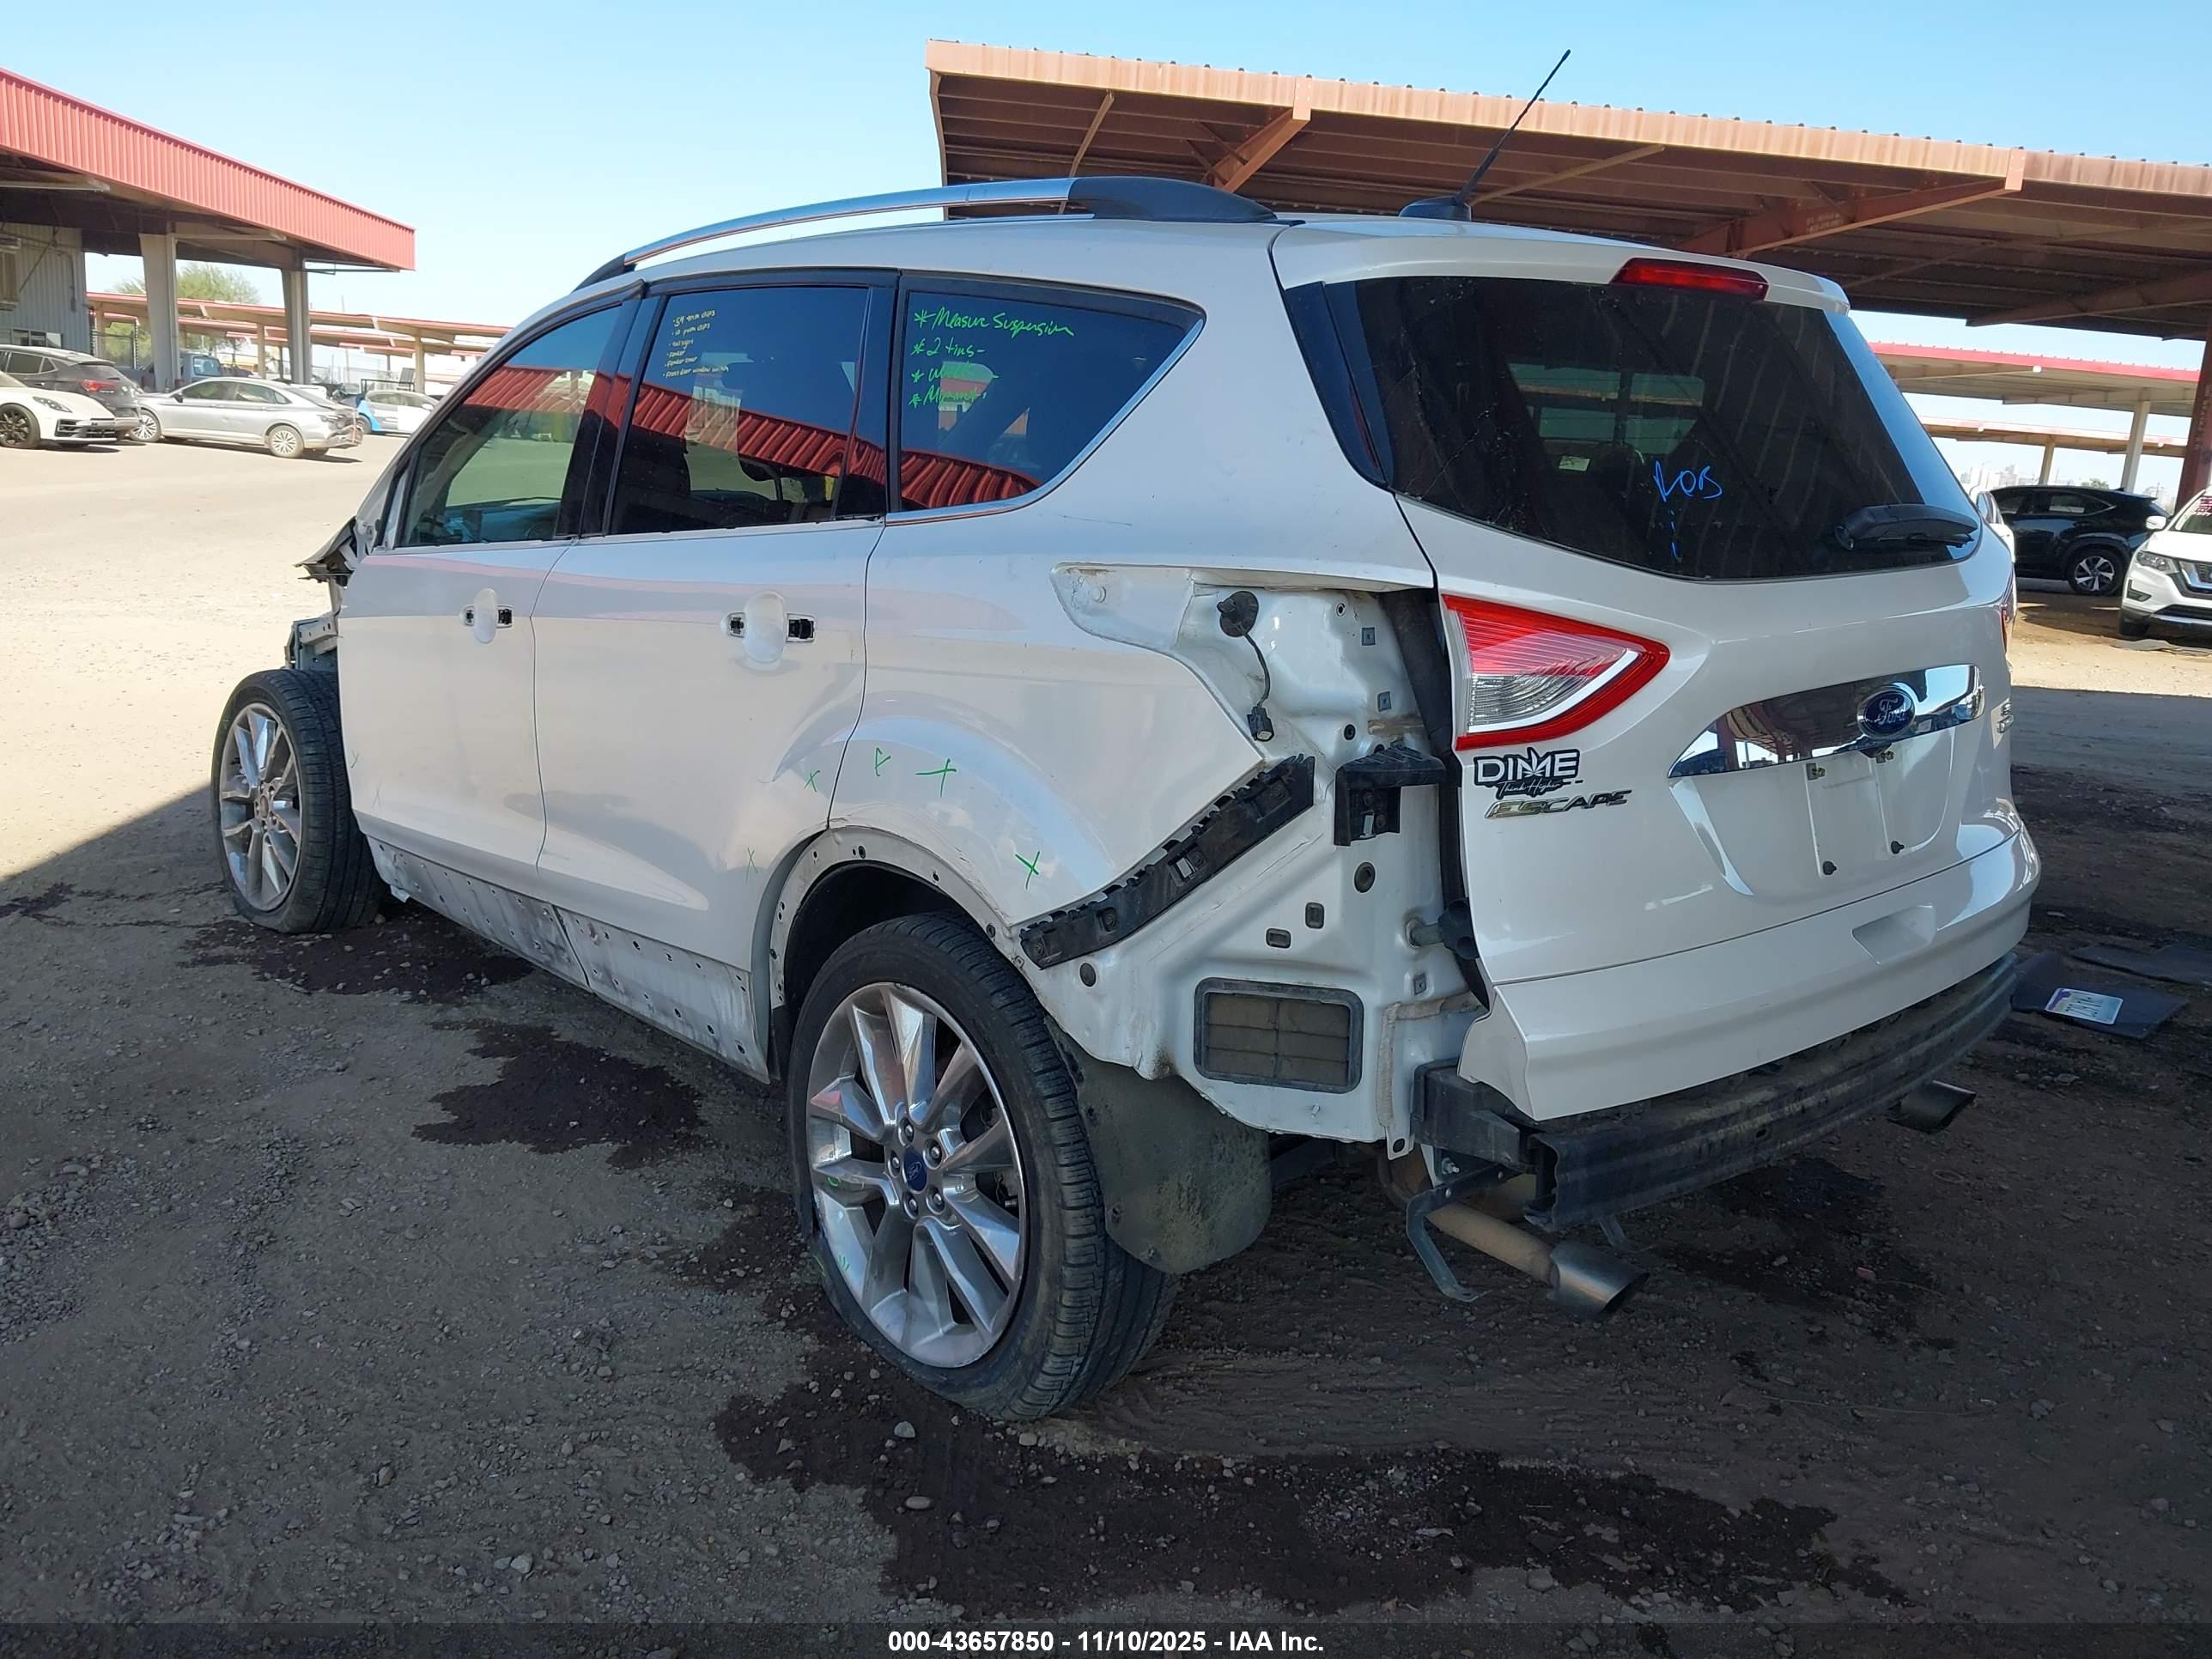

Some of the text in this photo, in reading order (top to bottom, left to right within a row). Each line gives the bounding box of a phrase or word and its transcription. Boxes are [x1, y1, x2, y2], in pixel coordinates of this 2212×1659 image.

[1476, 750, 1579, 783] DIME
[1498, 777, 1562, 798] Think Higher
[1484, 789, 1633, 819] ESCAPE
